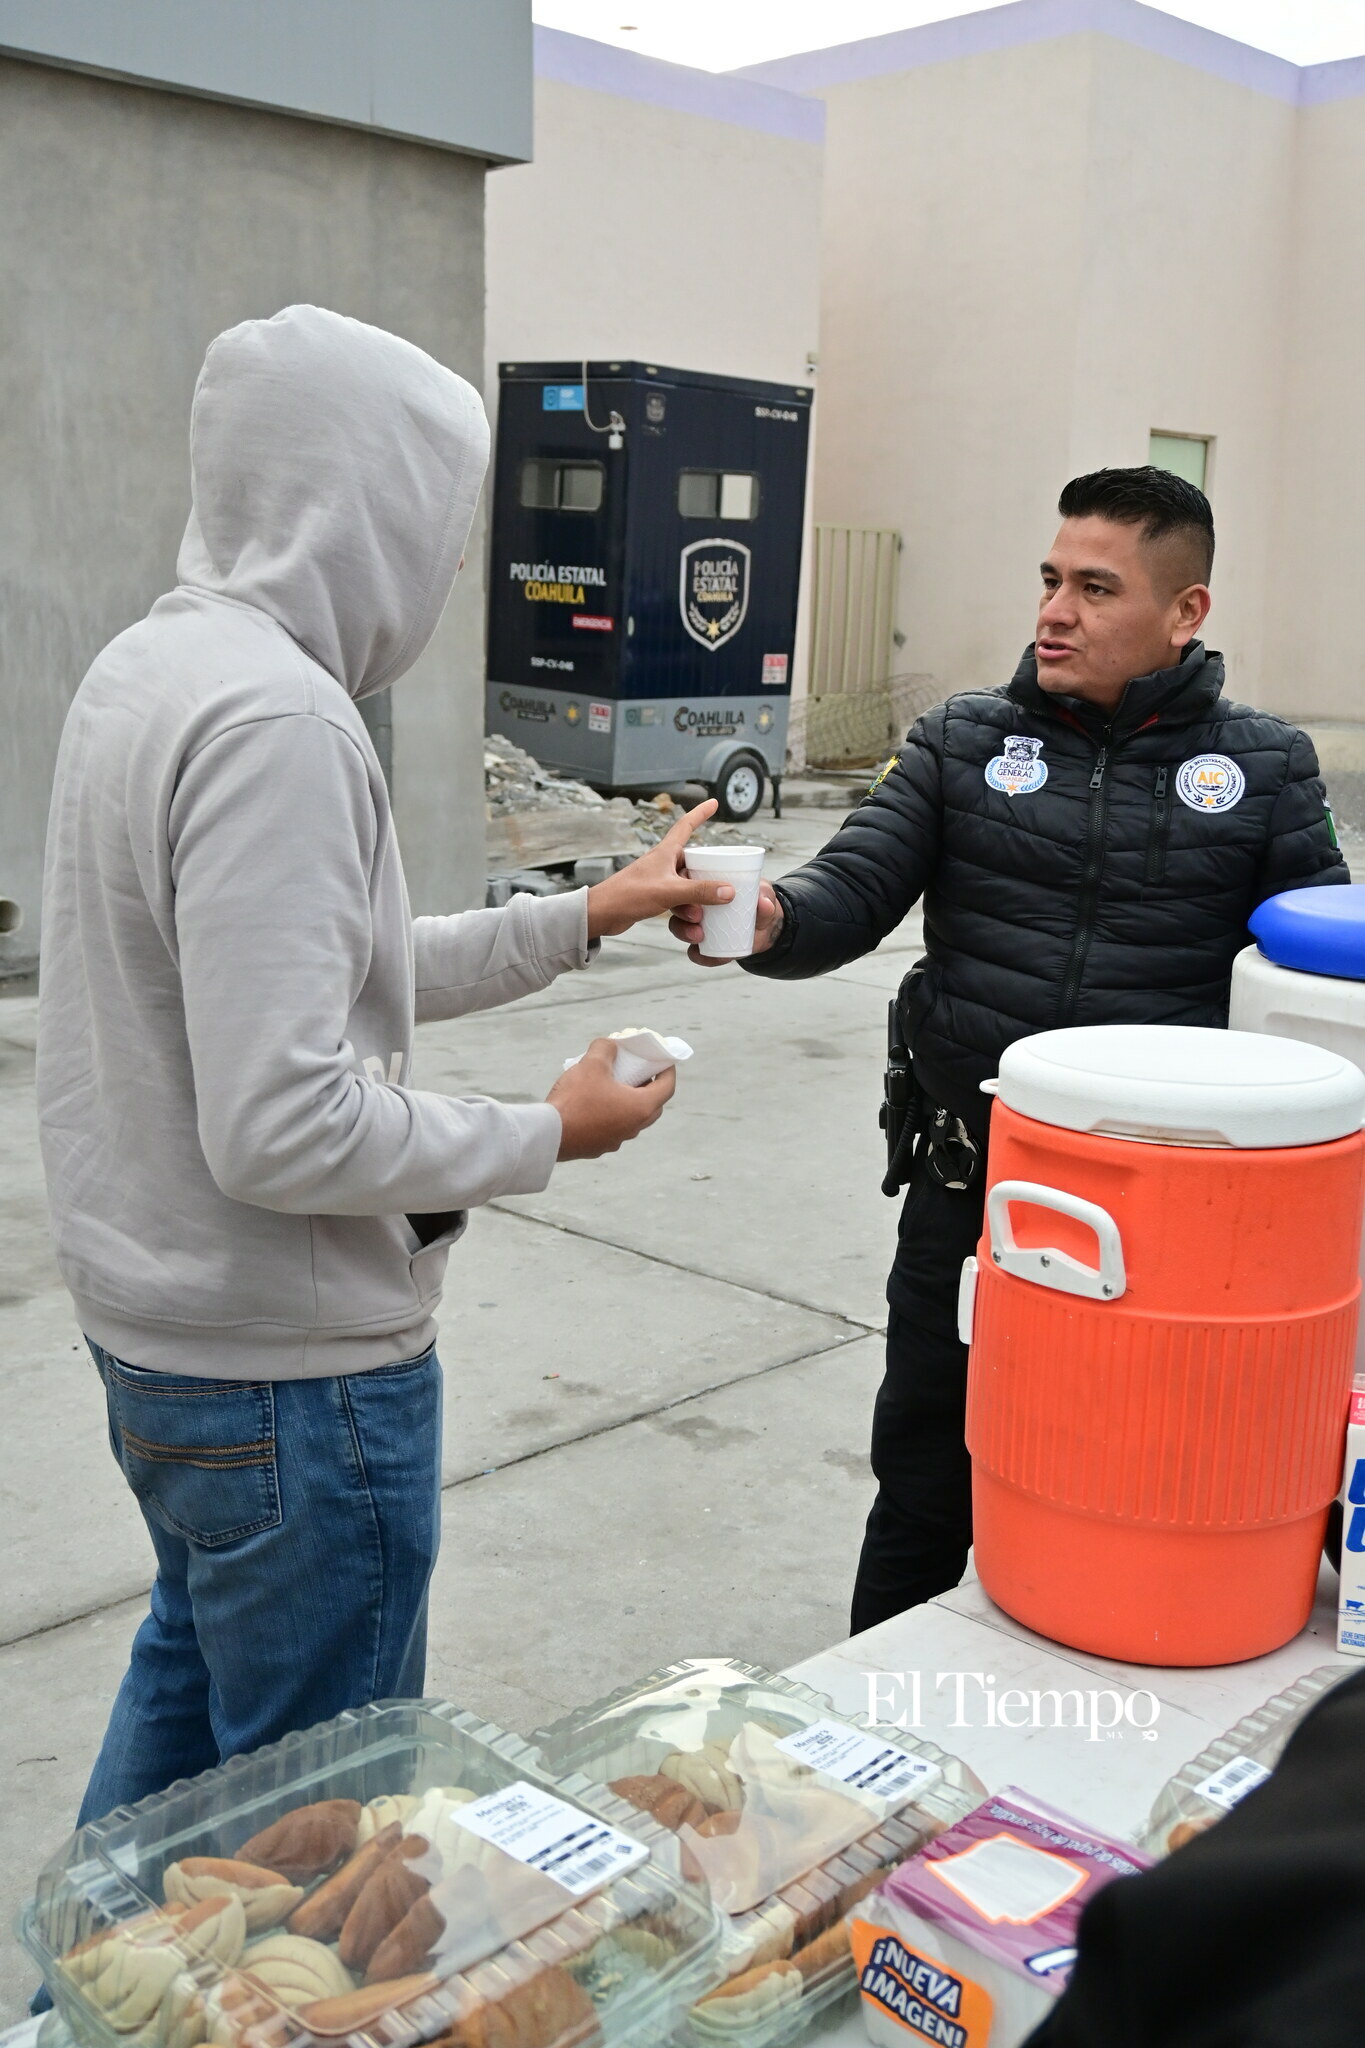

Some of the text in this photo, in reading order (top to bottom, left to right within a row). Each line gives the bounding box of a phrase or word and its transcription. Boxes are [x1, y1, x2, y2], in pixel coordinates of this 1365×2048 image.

[510, 559, 607, 587] POLICÍA ESTATAL
[694, 555, 739, 576] POLICÍA
[525, 580, 585, 605] COAHUILA
[693, 576, 738, 593] ESTATAL
[696, 591, 734, 603] COAHUILA
[673, 706, 745, 732] COAHUILA
[997, 769, 1033, 779] GENERAL
[999, 761, 1034, 772] FISCALÍA
[1196, 770, 1225, 785] AIC
[874, 1940, 960, 2014] ¡NUEVA
[862, 1968, 964, 2048] IMAGEN!
